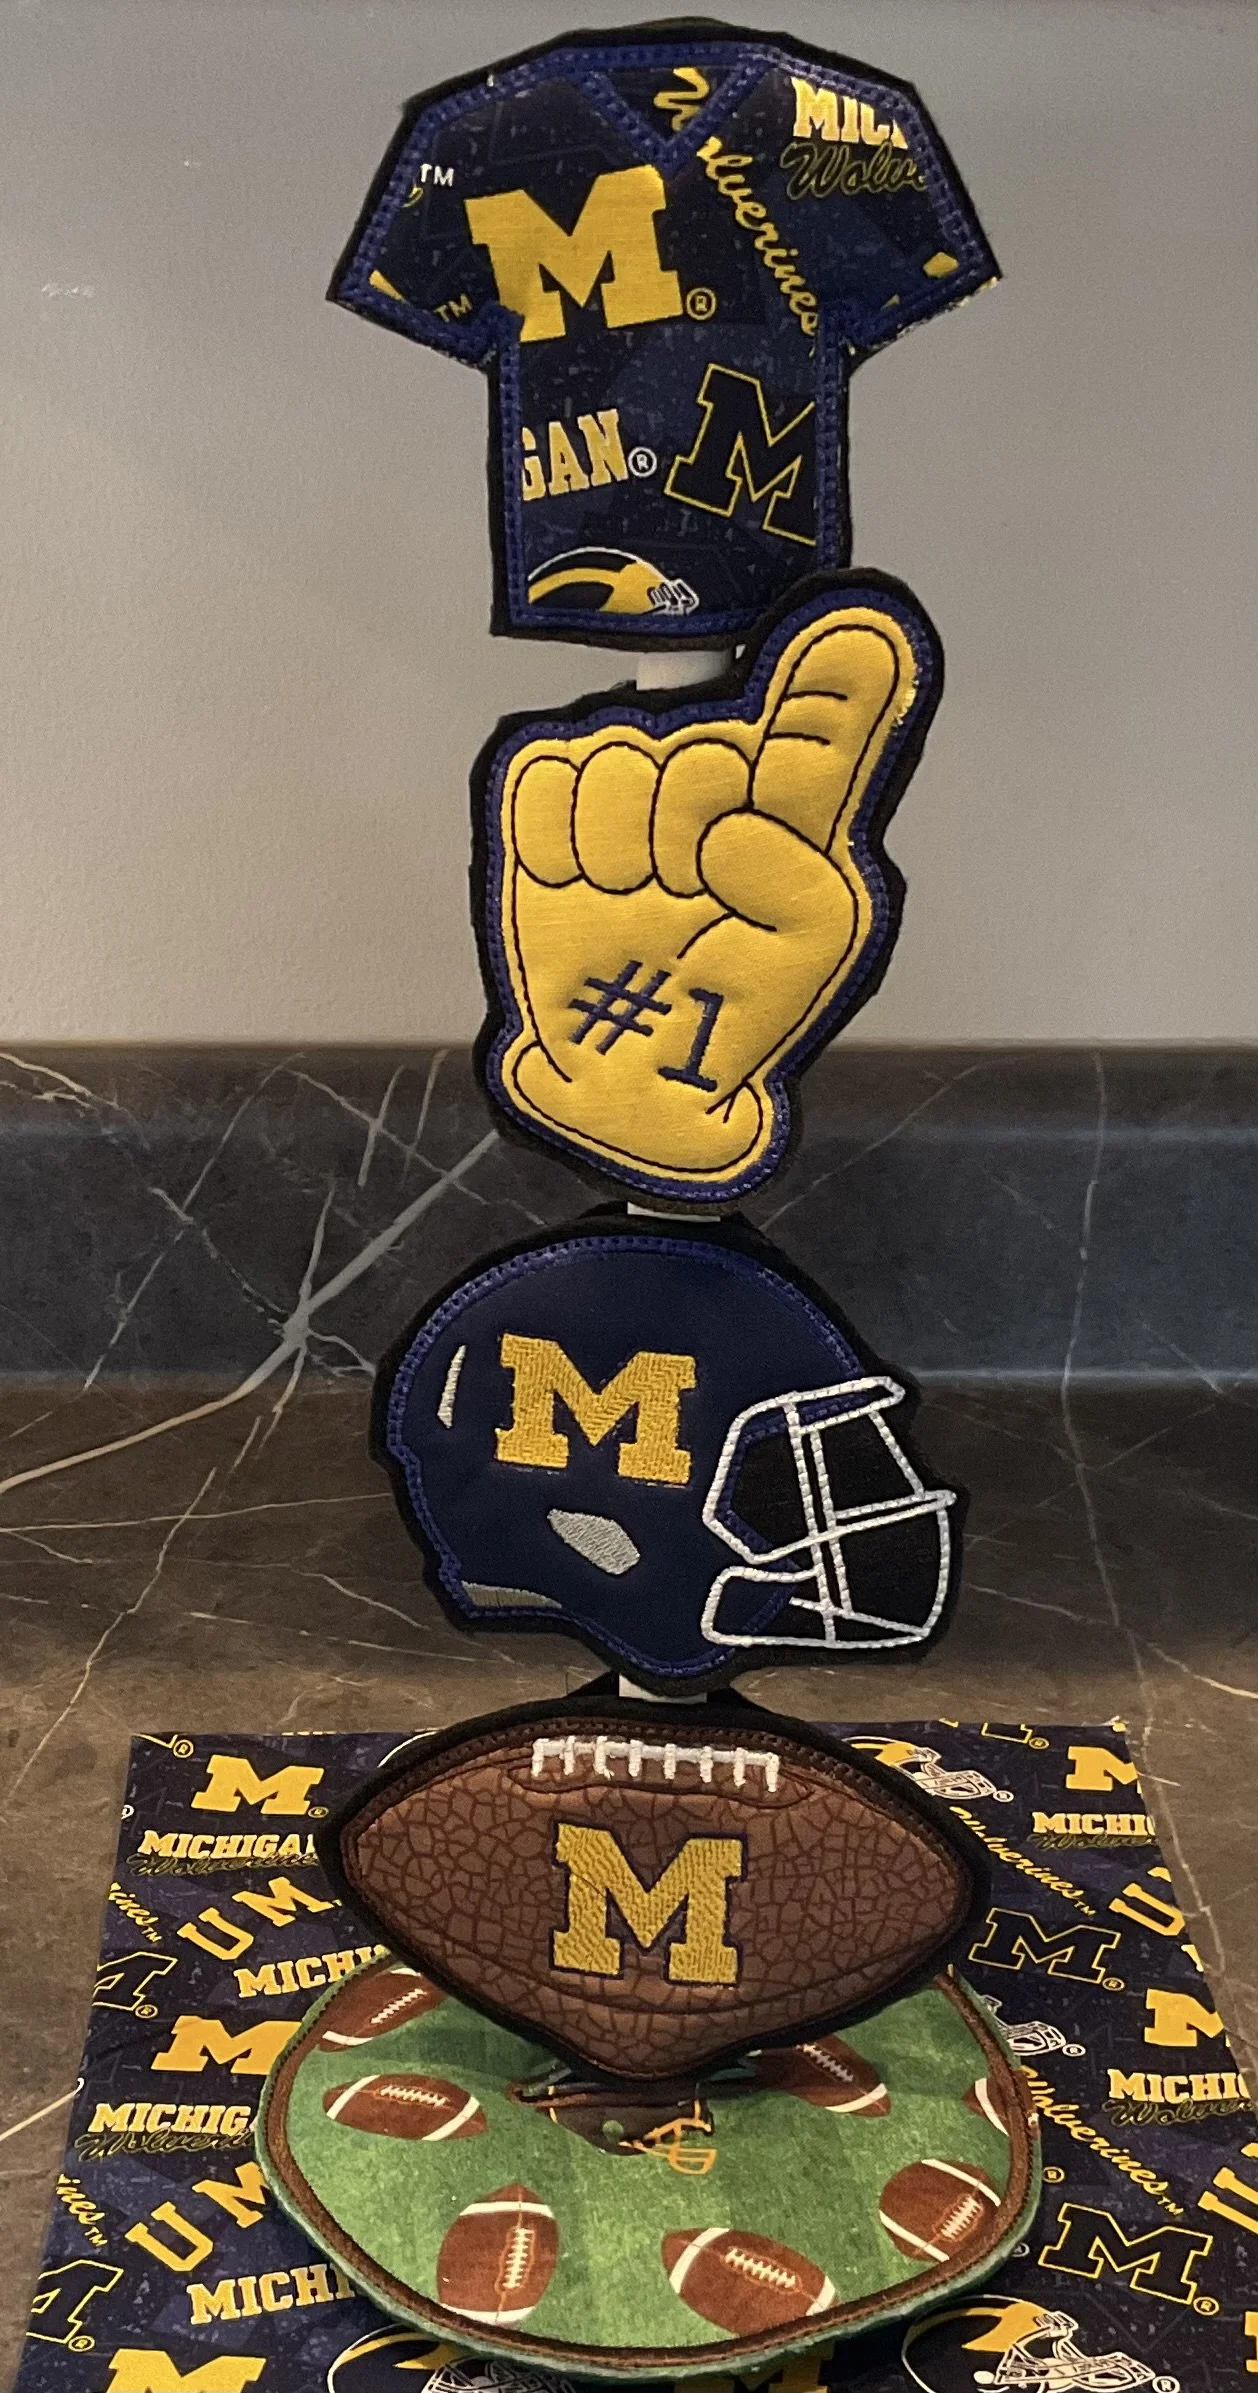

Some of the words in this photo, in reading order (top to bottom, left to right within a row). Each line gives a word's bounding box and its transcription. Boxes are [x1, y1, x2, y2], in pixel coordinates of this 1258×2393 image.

[464, 164, 684, 342] M
[566, 960, 724, 1092] #1
[495, 1332, 697, 1486] M
[191, 1754, 325, 1815] M
[551, 1820, 745, 1985] M
[969, 1907, 1121, 1984] M
[151, 2015, 302, 2075] M
[88, 2103, 255, 2136] MICHIG
[1038, 2203, 1213, 2304] M
